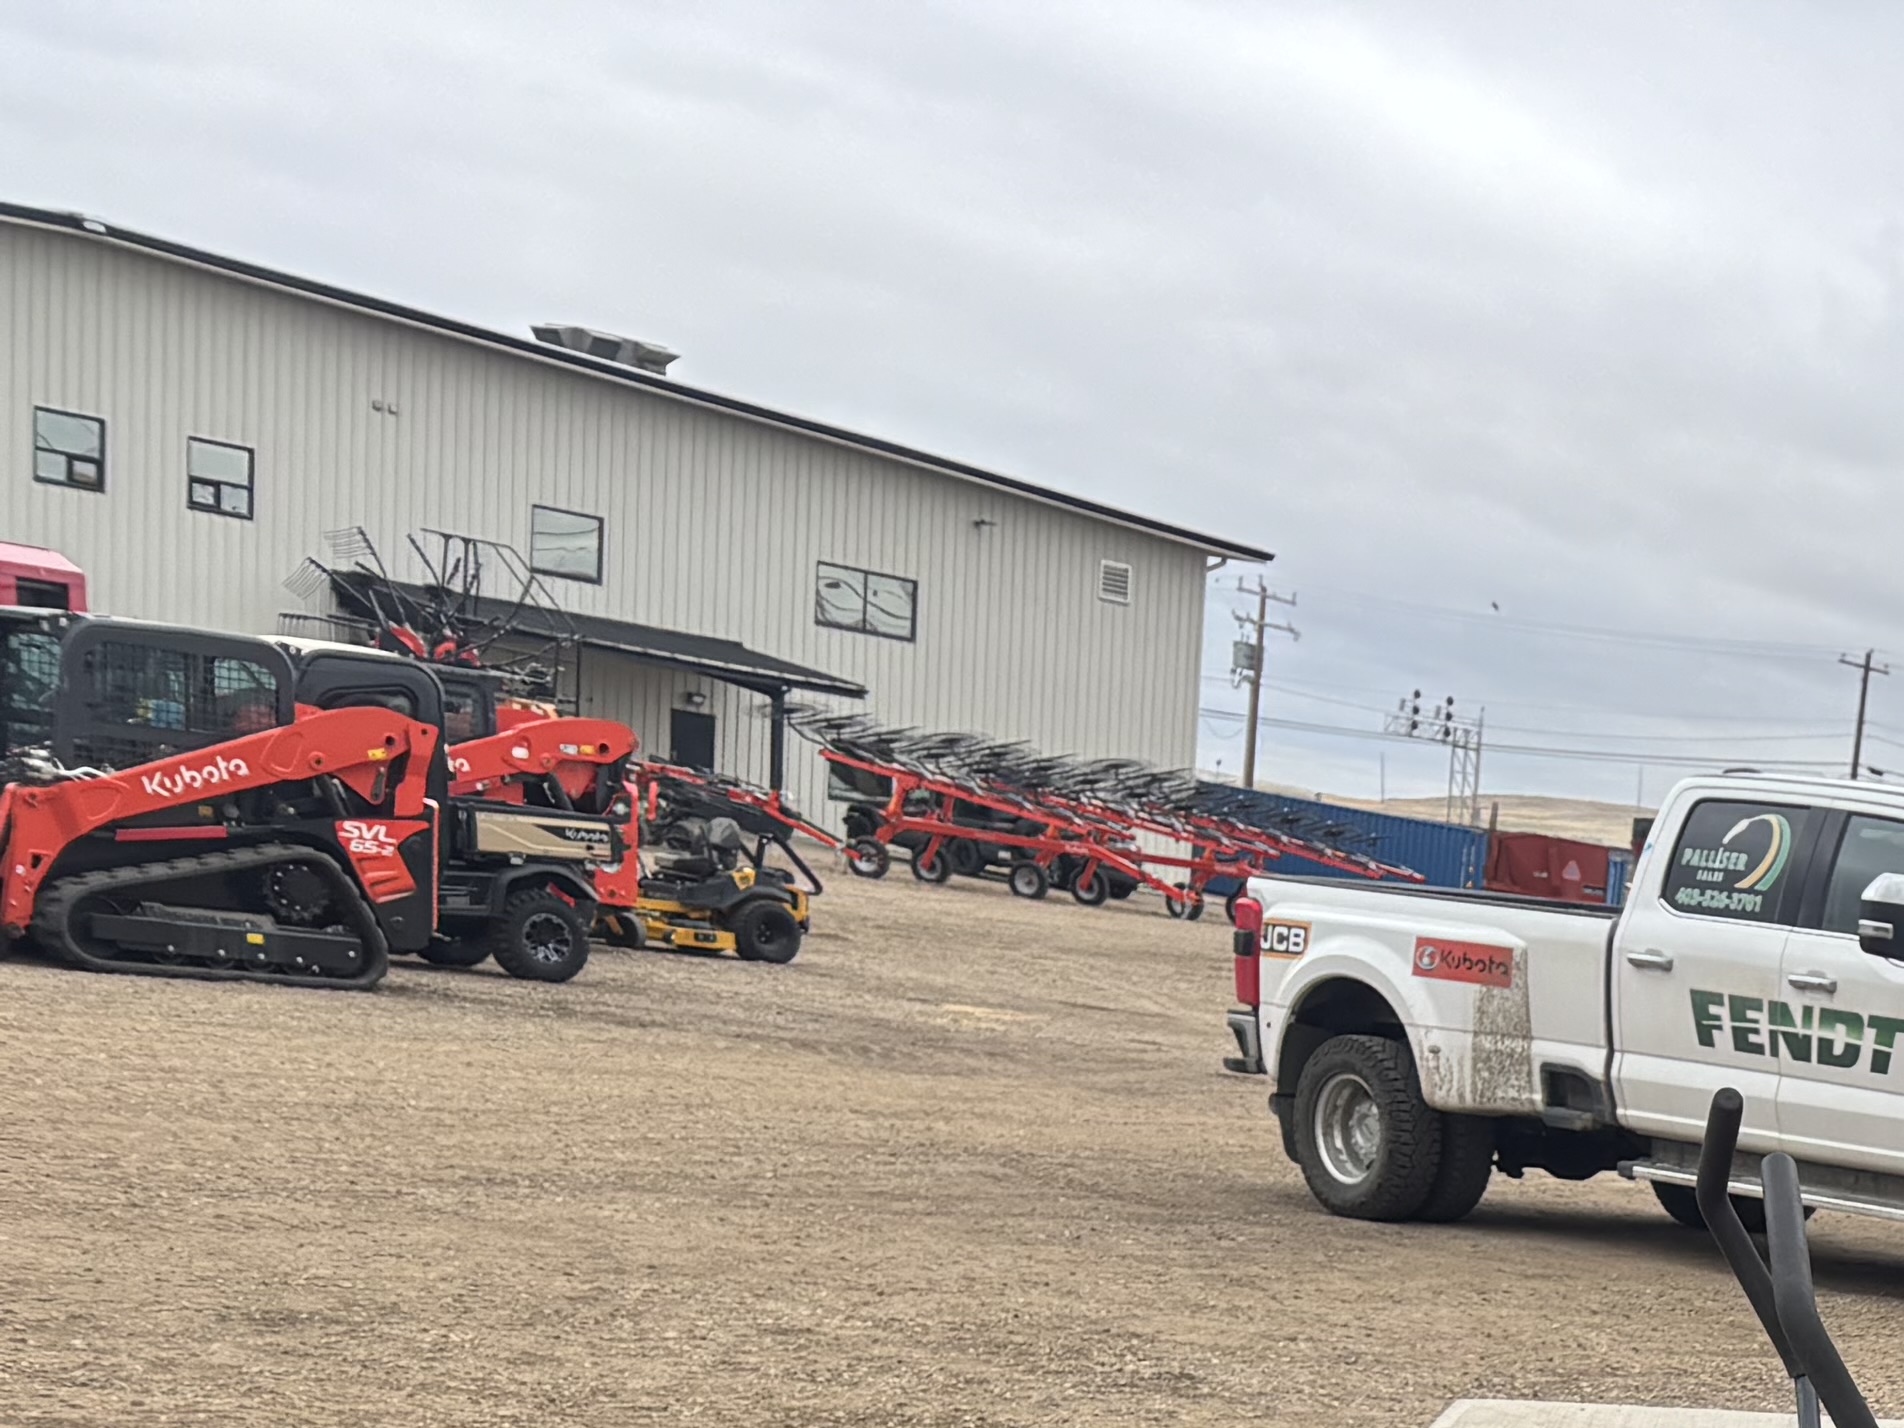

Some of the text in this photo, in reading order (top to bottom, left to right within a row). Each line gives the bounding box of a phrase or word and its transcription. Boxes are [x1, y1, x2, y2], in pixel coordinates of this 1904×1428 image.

[141, 756, 250, 798] Kubota
[340, 822, 397, 843] SVL
[349, 840, 394, 857] 65-2
[1260, 928, 1306, 952] JCB
[1440, 950, 1509, 976] Kubota
